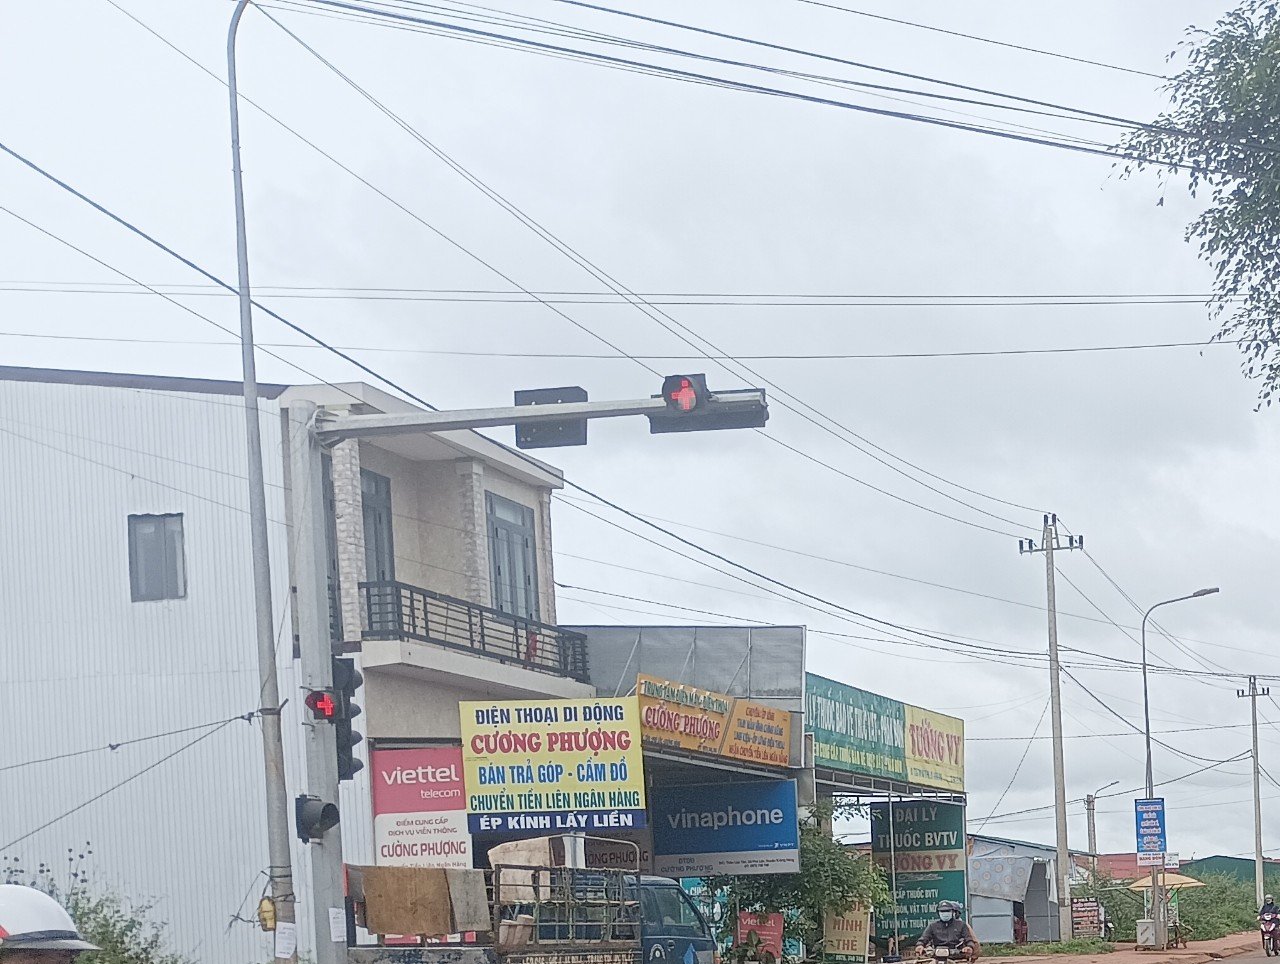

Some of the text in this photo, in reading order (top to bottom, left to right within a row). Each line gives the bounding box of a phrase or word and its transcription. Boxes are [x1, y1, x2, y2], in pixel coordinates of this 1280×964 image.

[475, 702, 624, 728] ĐIỆN THOẠI DI ĐỘNG
[546, 727, 632, 756] PHƯỢNG
[381, 764, 460, 785] viettel
[478, 762, 506, 785] BÁN
[508, 758, 534, 784] TRẢ
[537, 760, 563, 783] GÓP
[576, 756, 606, 782] CẦM
[610, 756, 628, 781] ĐỒ
[420, 789, 461, 799] telecom
[470, 787, 640, 811] CHUYỂN TIỀN LIÊN NGÂN HÀNG
[414, 818, 434, 826] CUNG
[479, 810, 633, 830] ÉP KÍNH LẤY LIỀN
[668, 806, 784, 830] vinaphone
[381, 840, 466, 858] CƯỜNG PHƯỢNG
[925, 831, 957, 847] BVTV
[935, 853, 959, 870] VY
